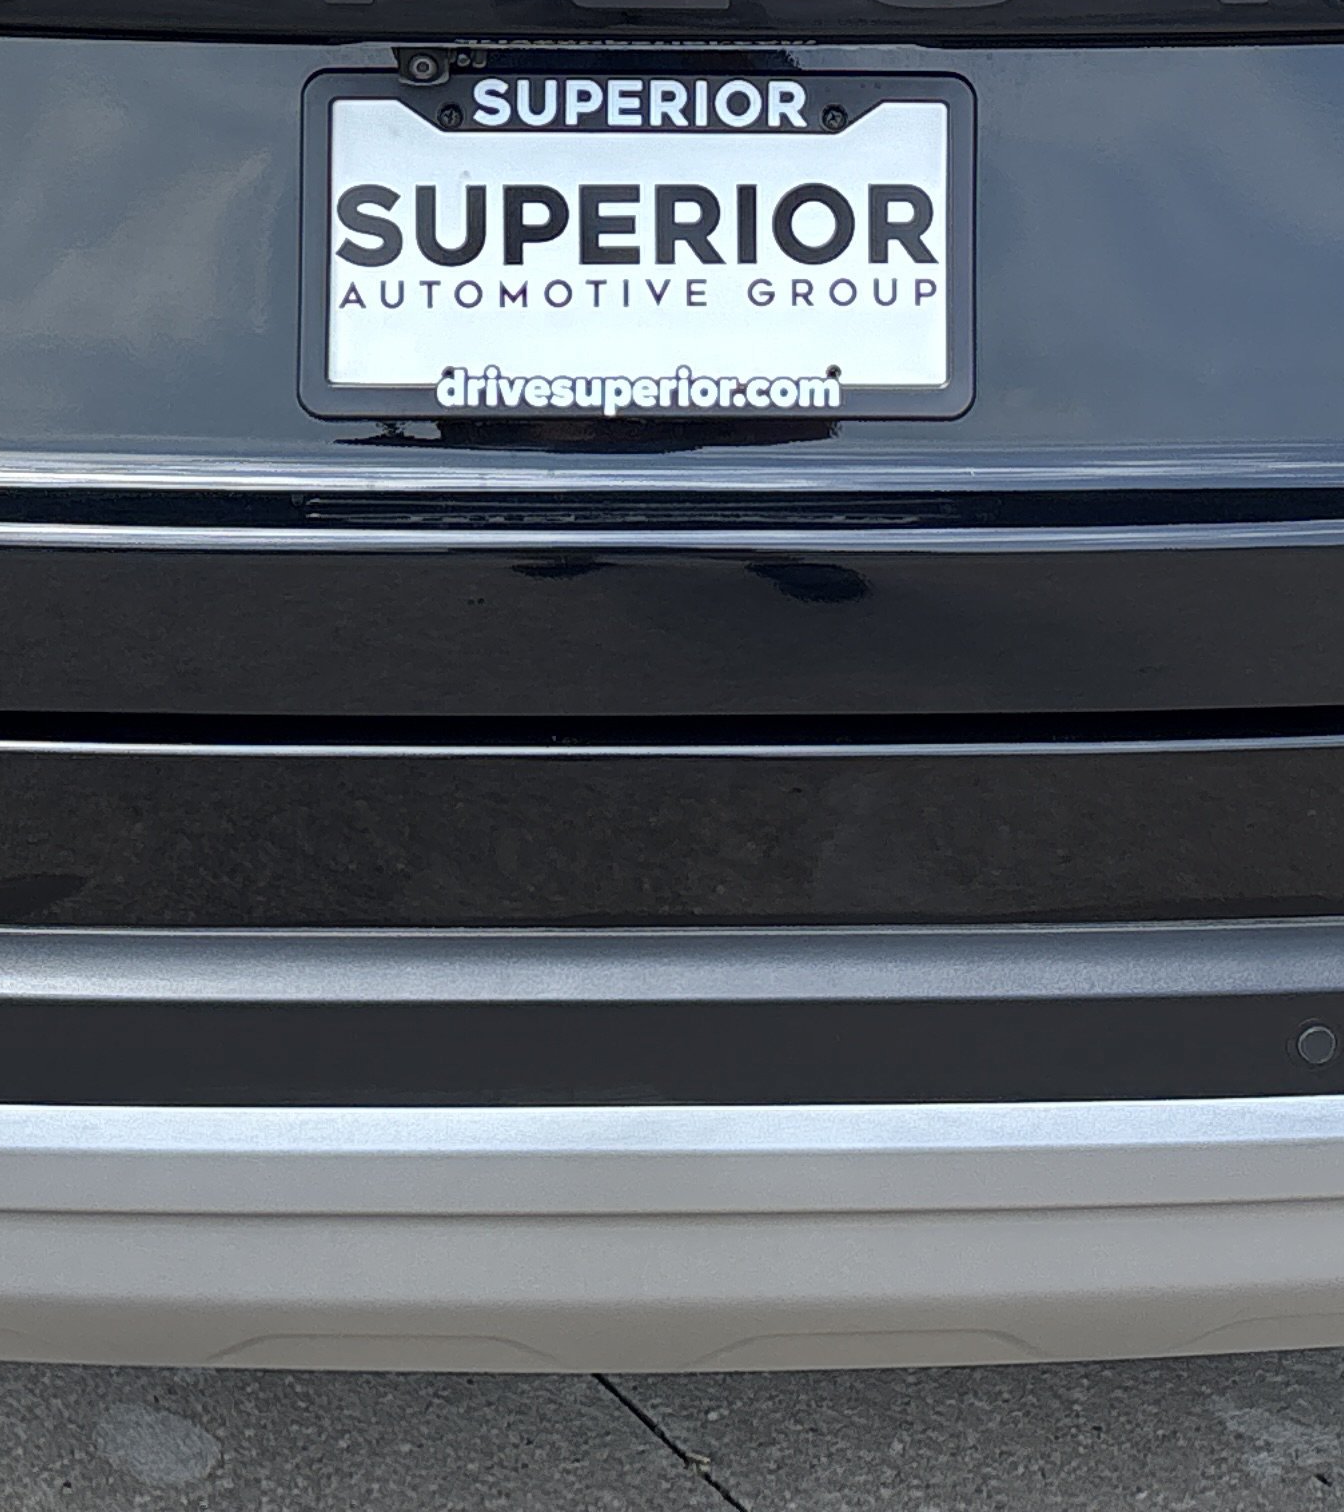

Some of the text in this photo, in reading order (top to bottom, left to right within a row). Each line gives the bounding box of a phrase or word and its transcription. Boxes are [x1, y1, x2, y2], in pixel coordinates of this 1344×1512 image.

[472, 77, 808, 128] SUPERIOR
[335, 182, 940, 267] SUPERIOR
[338, 278, 938, 309] AUTOMOTIVE GROUP
[436, 364, 840, 416] drivesuperior.com
